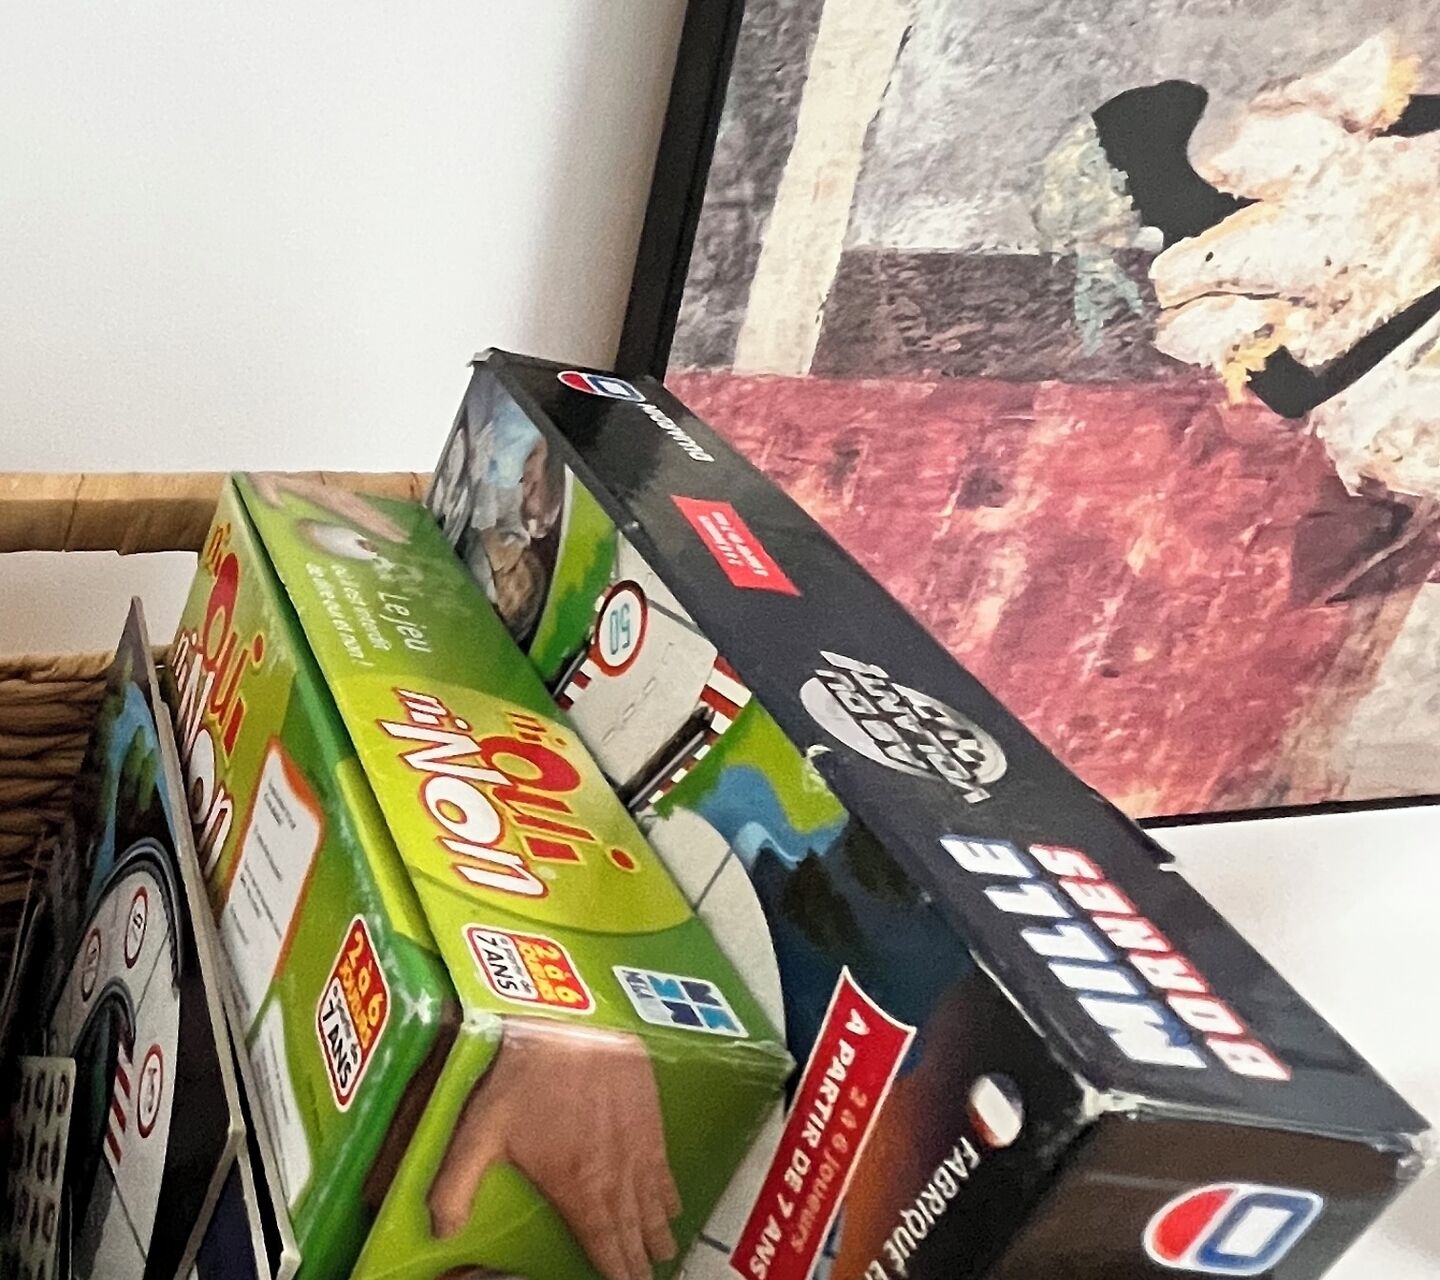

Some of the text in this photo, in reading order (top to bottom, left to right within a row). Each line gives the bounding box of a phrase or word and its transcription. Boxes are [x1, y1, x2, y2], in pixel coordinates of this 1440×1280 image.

[377, 591, 432, 653] Le jeu
[347, 931, 364, 967] 2
[367, 993, 384, 1028] 6
[476, 934, 519, 993] 7 ANS
[531, 942, 561, 961] 2
[554, 985, 584, 1003] 6
[940, 834, 1208, 1069] MILLE
[1028, 843, 1293, 1081] BORNES
[322, 999, 352, 1089] 7 ANS
[801, 1038, 856, 1149] PARTIR
[776, 1192, 794, 1219] 7
[783, 1147, 812, 1194] DE
[790, 1145, 841, 1255] joueurs
[882, 1135, 982, 1279] FABRIQUÉ
